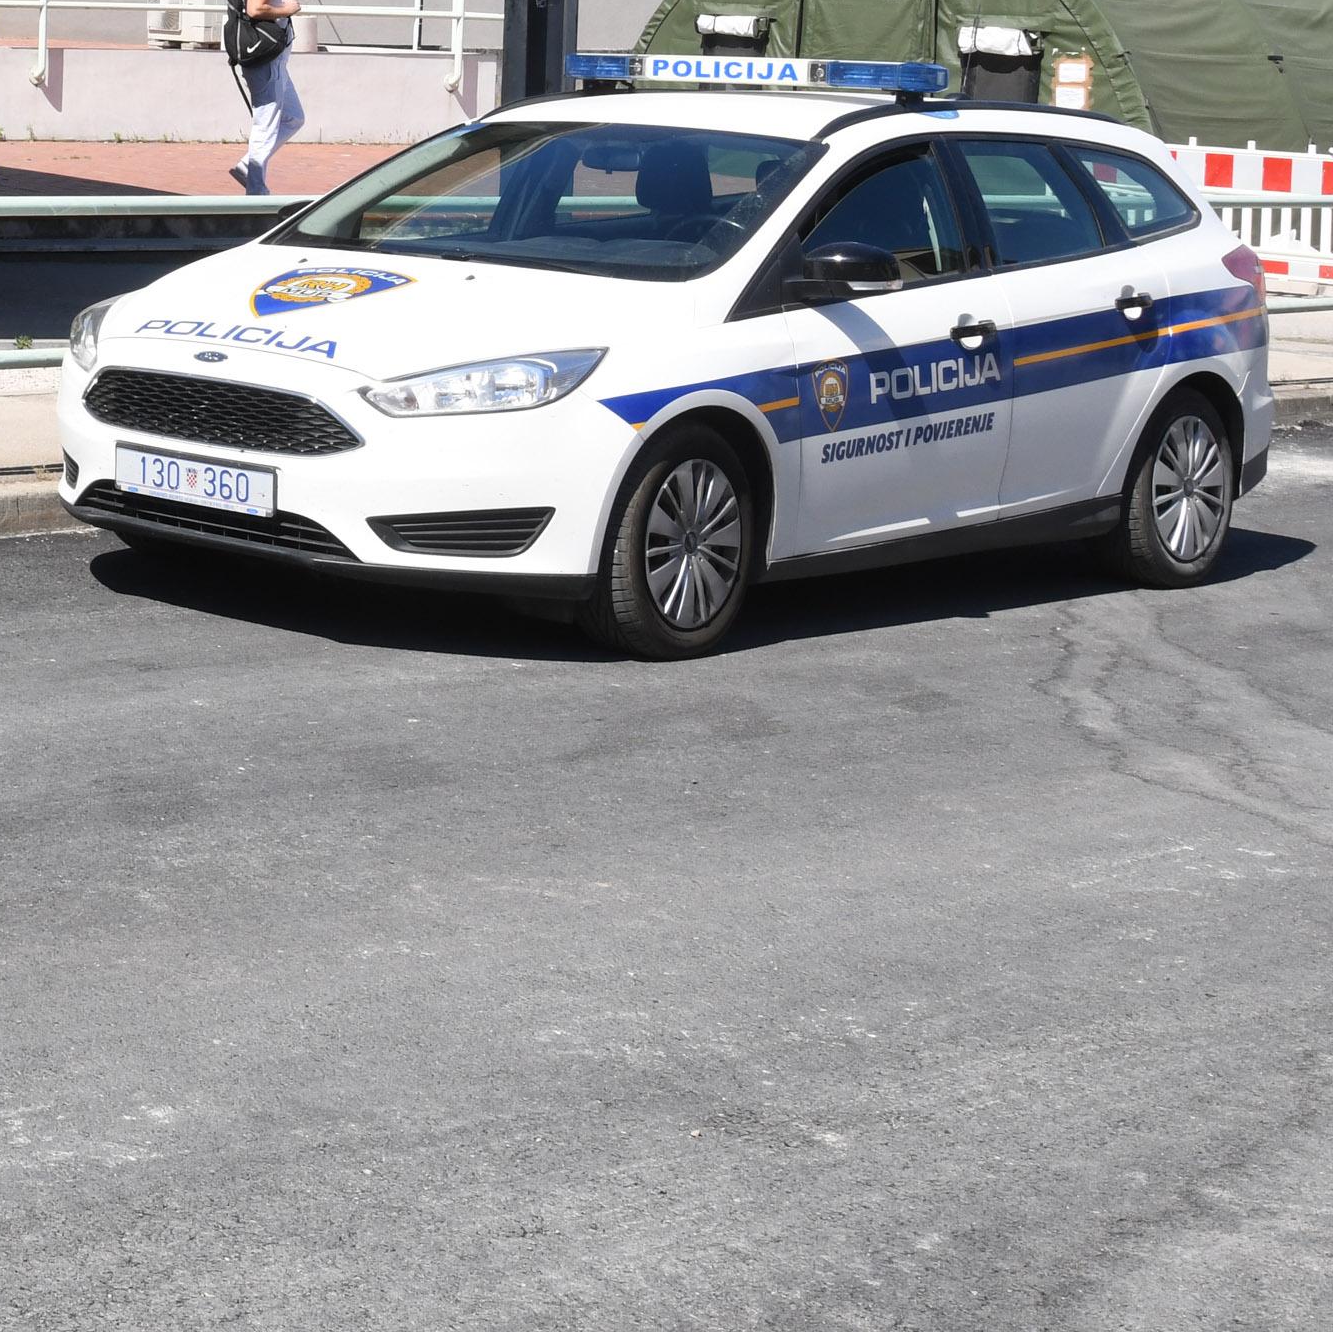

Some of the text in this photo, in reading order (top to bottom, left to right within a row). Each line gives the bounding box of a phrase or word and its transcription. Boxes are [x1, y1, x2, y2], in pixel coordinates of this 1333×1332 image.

[652, 59, 798, 81] POLICIJA
[296, 268, 411, 285] POLICIJA
[135, 319, 338, 359] POLICIJA
[869, 353, 1002, 405] POLICIJA
[821, 412, 995, 464] SIGURNOST I POVJERENJE
[140, 456, 180, 490] 130
[203, 467, 249, 503] 360
